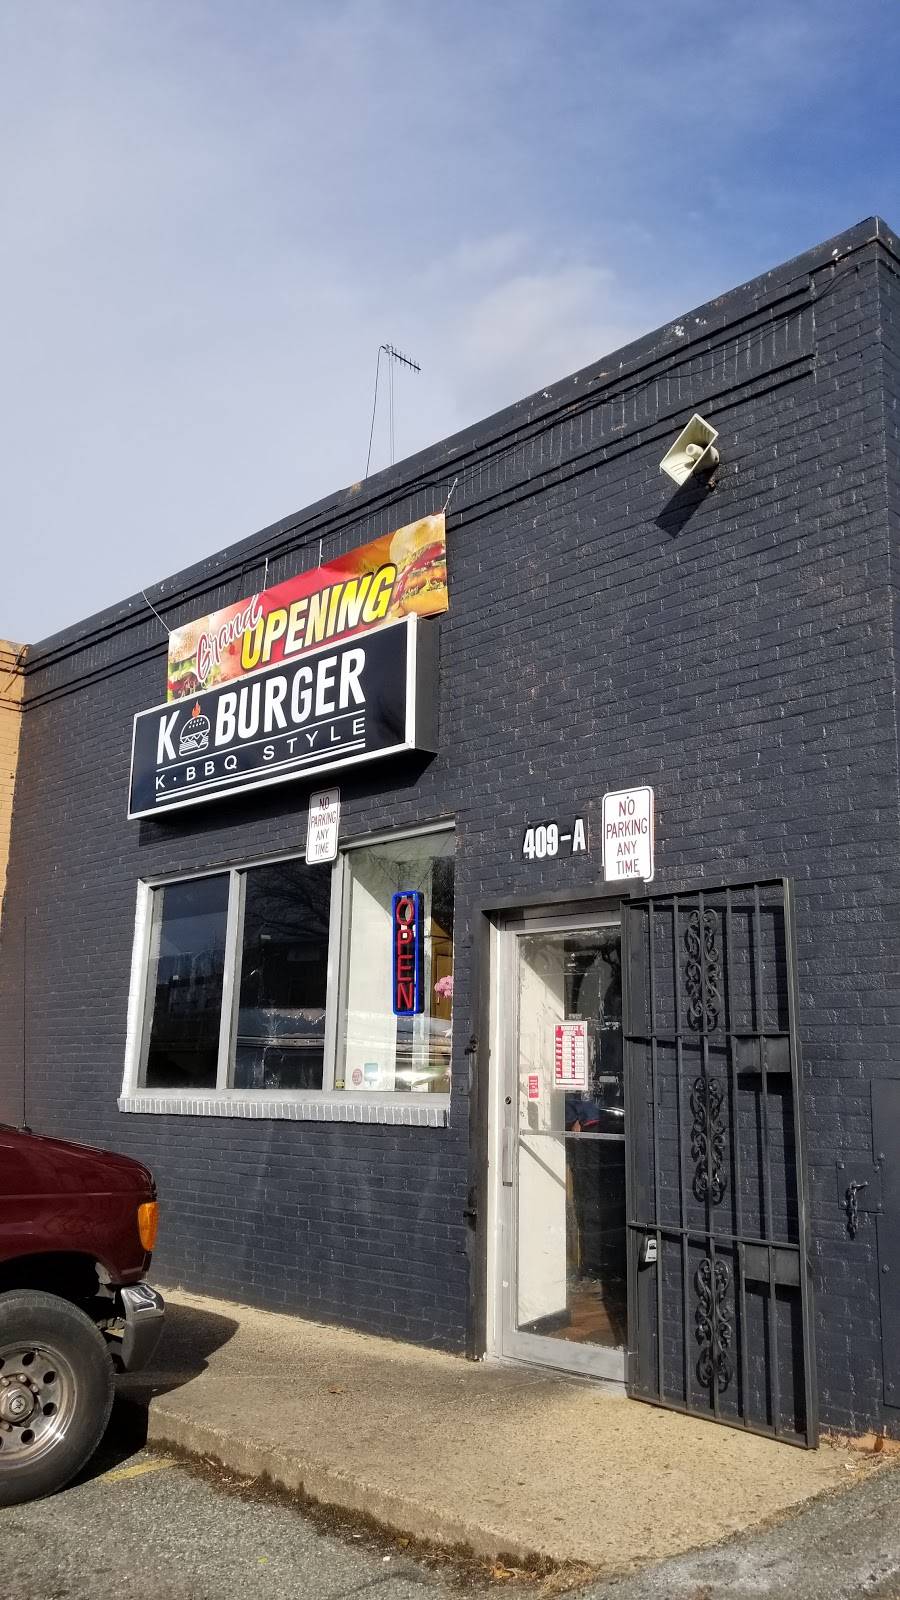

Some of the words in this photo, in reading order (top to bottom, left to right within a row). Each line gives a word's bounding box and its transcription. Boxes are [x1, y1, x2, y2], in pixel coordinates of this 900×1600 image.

[241, 564, 397, 670] OPENING
[197, 593, 263, 682] Grand
[156, 710, 181, 765] K
[215, 647, 366, 747] BURGER
[263, 718, 366, 761] STYLE
[319, 796, 330, 811] NO
[618, 799, 635, 817] NO
[311, 811, 336, 829] PARKING
[606, 818, 648, 840] PARKING
[315, 828, 329, 842] ANY
[522, 818, 587, 860] 409-A
[314, 841, 330, 856] TIME
[616, 840, 638, 857] ANY
[616, 858, 640, 875] TIME
[396, 898, 415, 1009] OPEN
